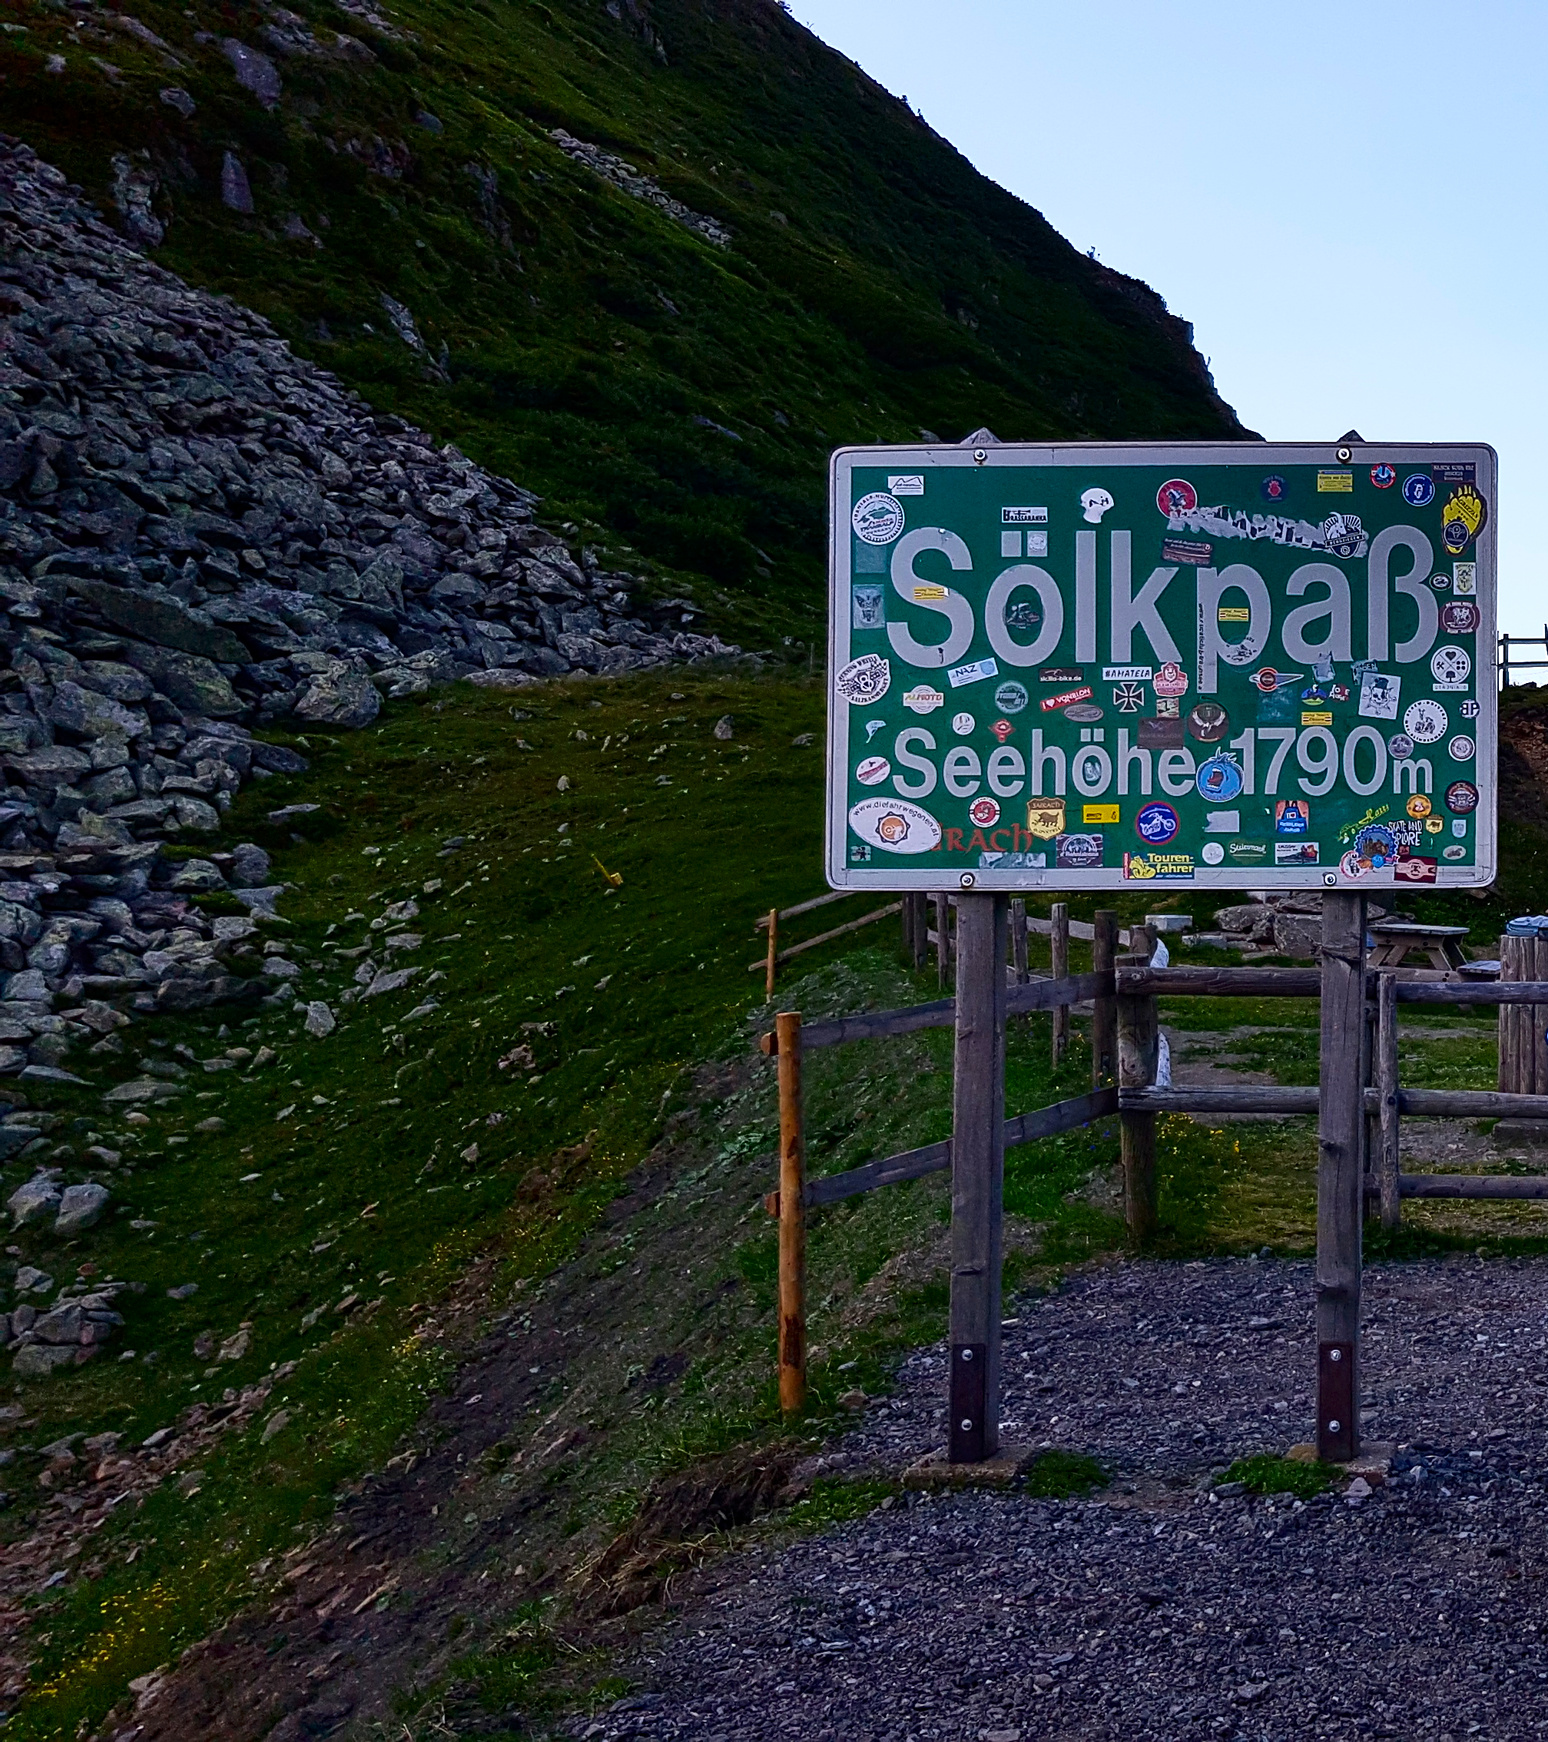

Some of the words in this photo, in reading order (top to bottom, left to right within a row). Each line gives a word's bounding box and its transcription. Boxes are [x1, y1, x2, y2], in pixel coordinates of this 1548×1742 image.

[886, 524, 1439, 693] Sölkpaß
[892, 727, 1196, 799] Seehöhe
[1230, 724, 1388, 797] 1790
[1393, 757, 1433, 795] m
[1408, 820, 1423, 832] AND
[1147, 852, 1195, 863] Touren-
[1155, 863, 1195, 874] fahrer
